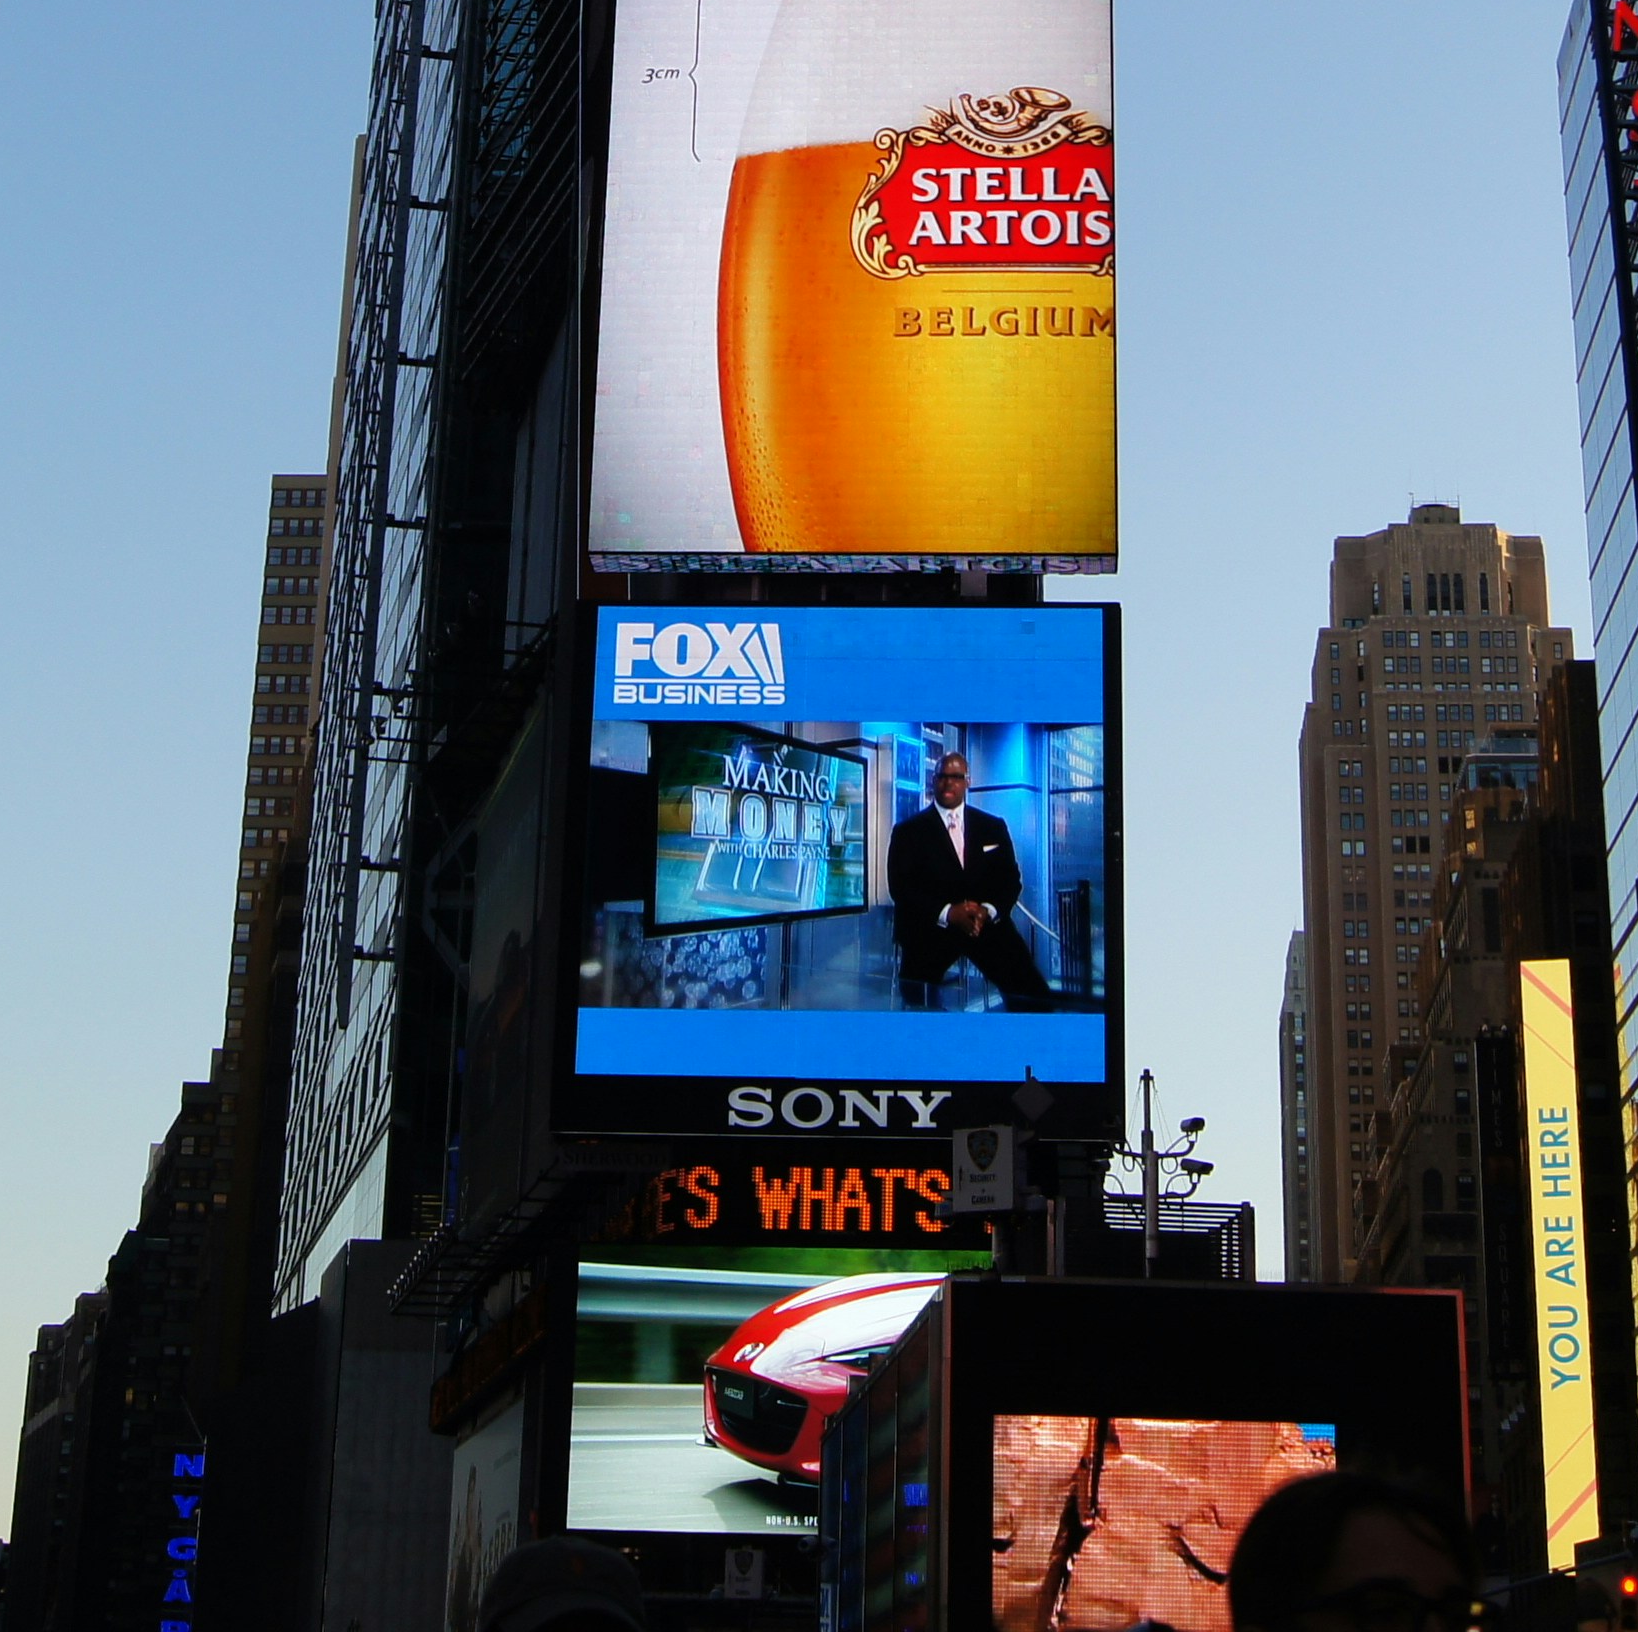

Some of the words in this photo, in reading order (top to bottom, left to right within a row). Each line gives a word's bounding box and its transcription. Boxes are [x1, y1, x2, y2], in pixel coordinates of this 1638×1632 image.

[641, 65, 680, 84] 3cm
[952, 129, 997, 154] ANNO
[1021, 130, 1062, 153] 1366
[910, 167, 1110, 202] STELLA
[908, 209, 1112, 246] ARTOIS
[892, 306, 1114, 338] BELGIUM
[615, 622, 763, 679] FOX
[613, 683, 785, 706] BUSINESS
[722, 754, 830, 802] MAKING
[692, 785, 848, 847] MONEY
[716, 841, 743, 855] WITH
[743, 842, 798, 860] CHARLES
[728, 1087, 952, 1129] SONY
[1538, 1106, 1572, 1198] HERE
[1543, 1215, 1577, 1287] ARE
[1547, 1304, 1582, 1391] YOU
